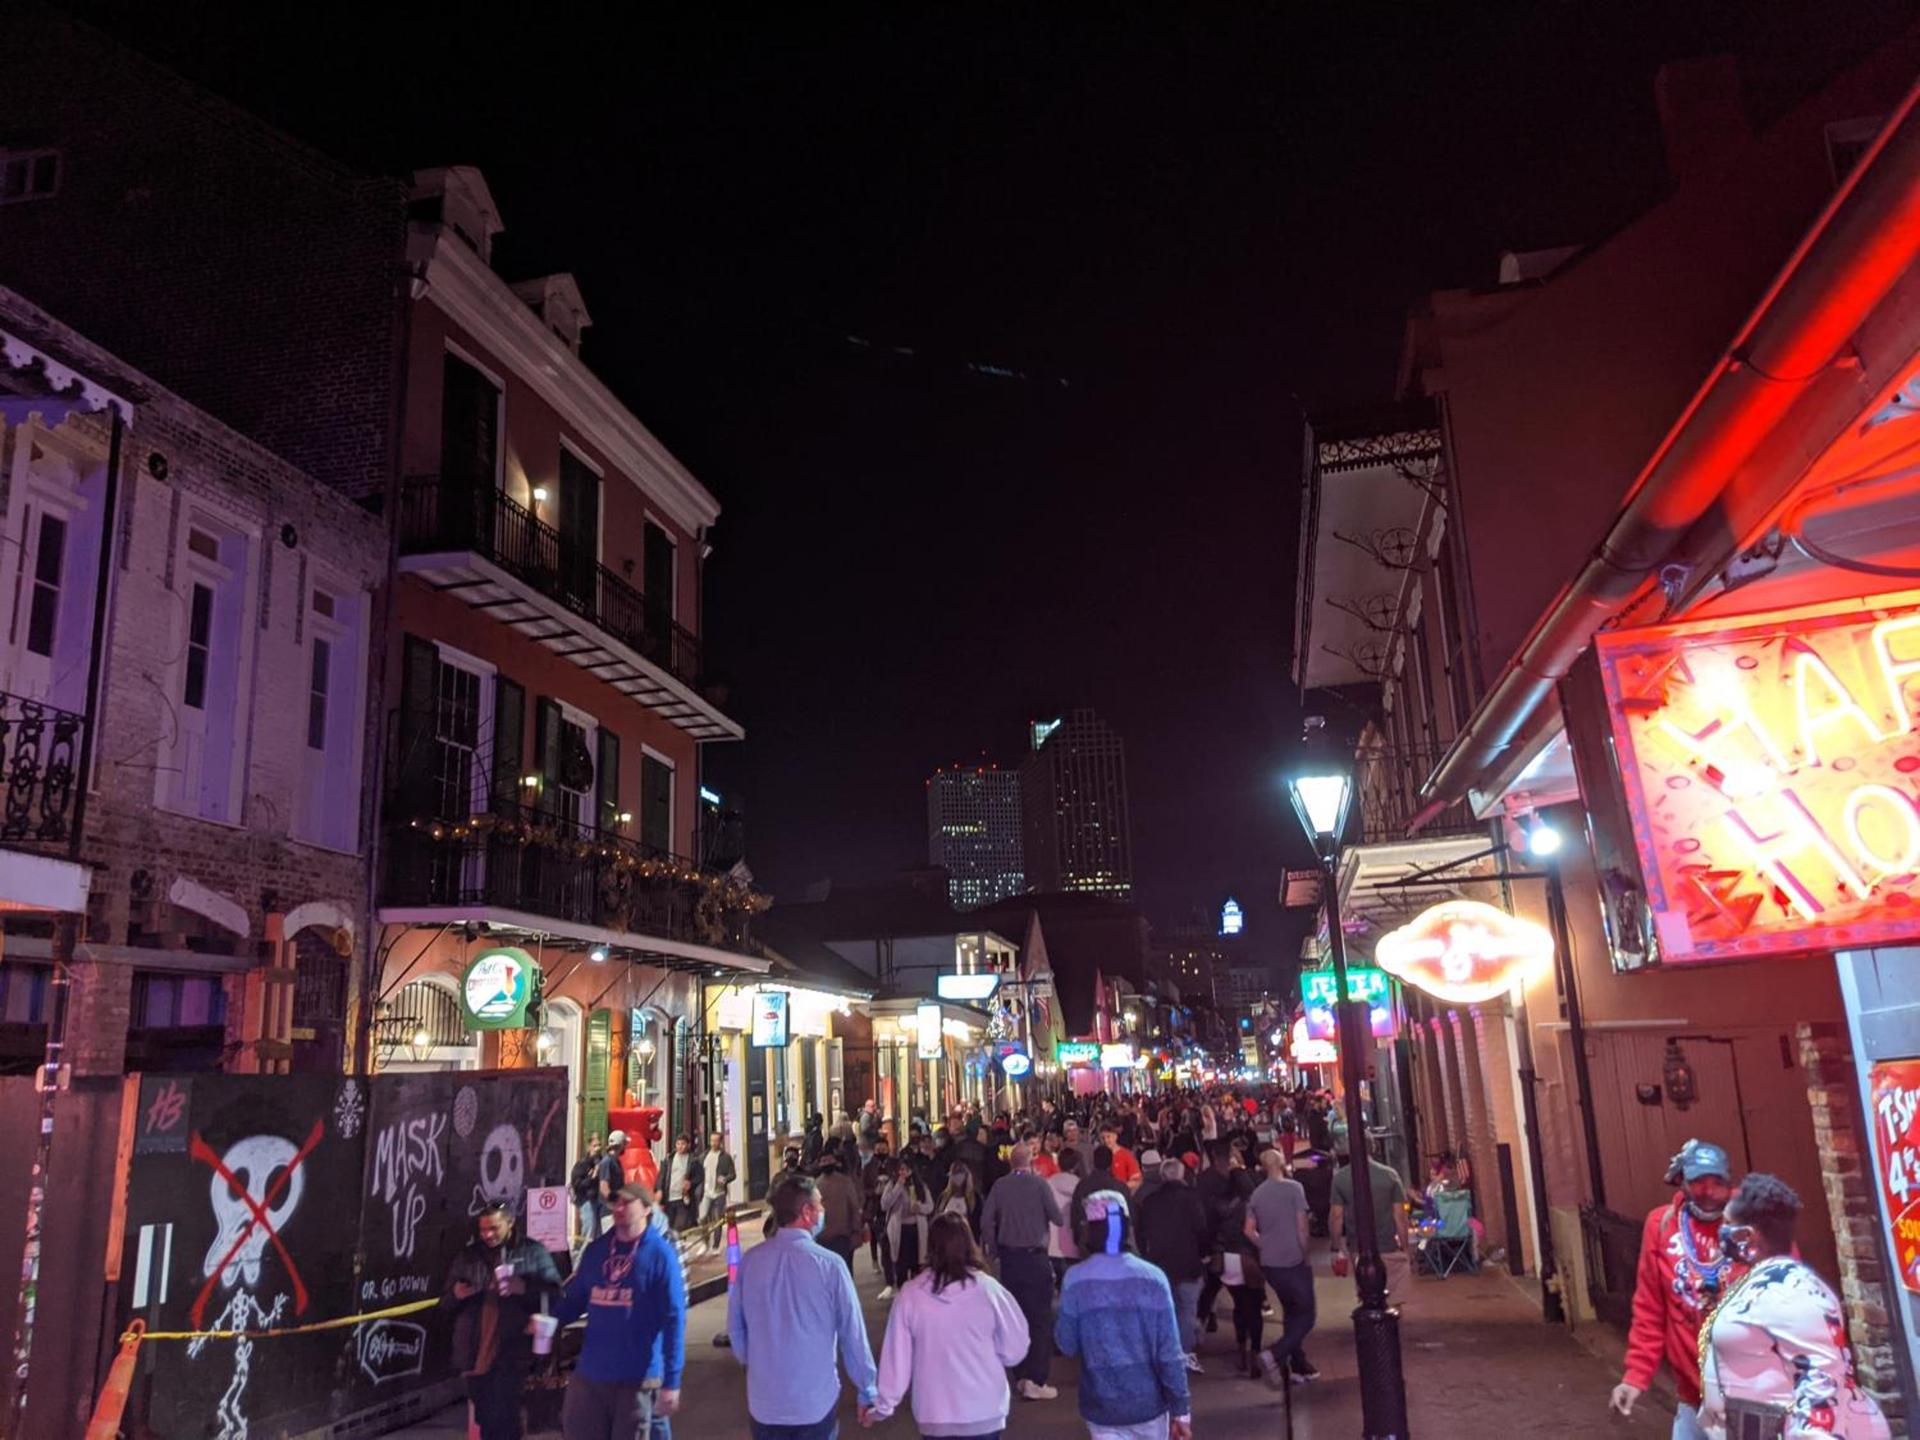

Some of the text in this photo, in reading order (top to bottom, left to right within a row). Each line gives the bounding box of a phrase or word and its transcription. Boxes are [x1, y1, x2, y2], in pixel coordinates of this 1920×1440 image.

[371, 1112, 448, 1204] MASK
[392, 1182, 427, 1258] UP
[382, 1278, 397, 1300] GO
[399, 1275, 430, 1293] DOWN
